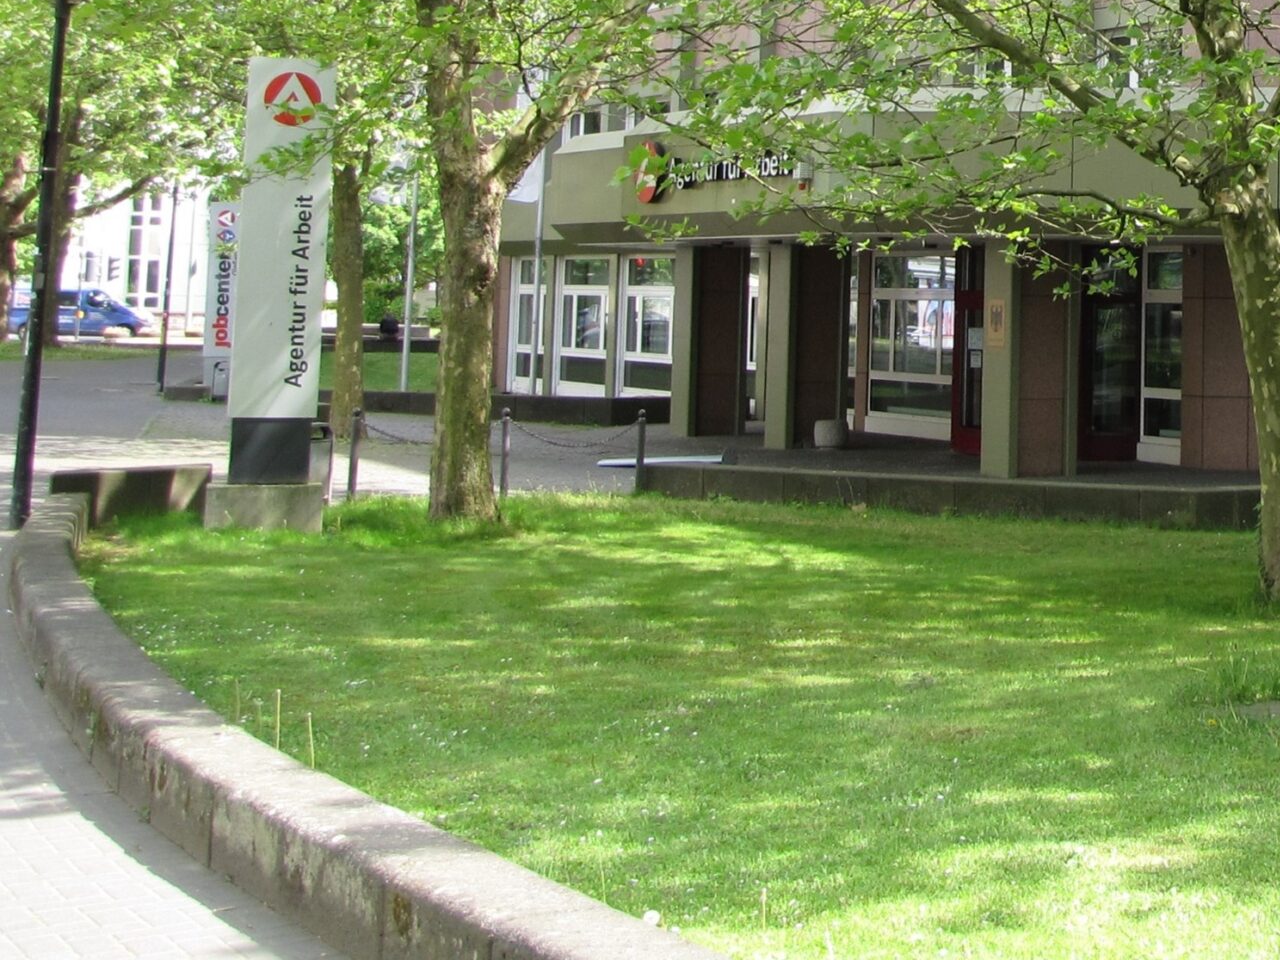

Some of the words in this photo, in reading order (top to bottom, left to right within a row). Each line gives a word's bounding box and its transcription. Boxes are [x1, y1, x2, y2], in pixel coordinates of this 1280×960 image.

[292, 195, 313, 260] Arbeit
[212, 250, 232, 349] jobcenter
[289, 264, 308, 295] für
[284, 301, 308, 388] Agentur
